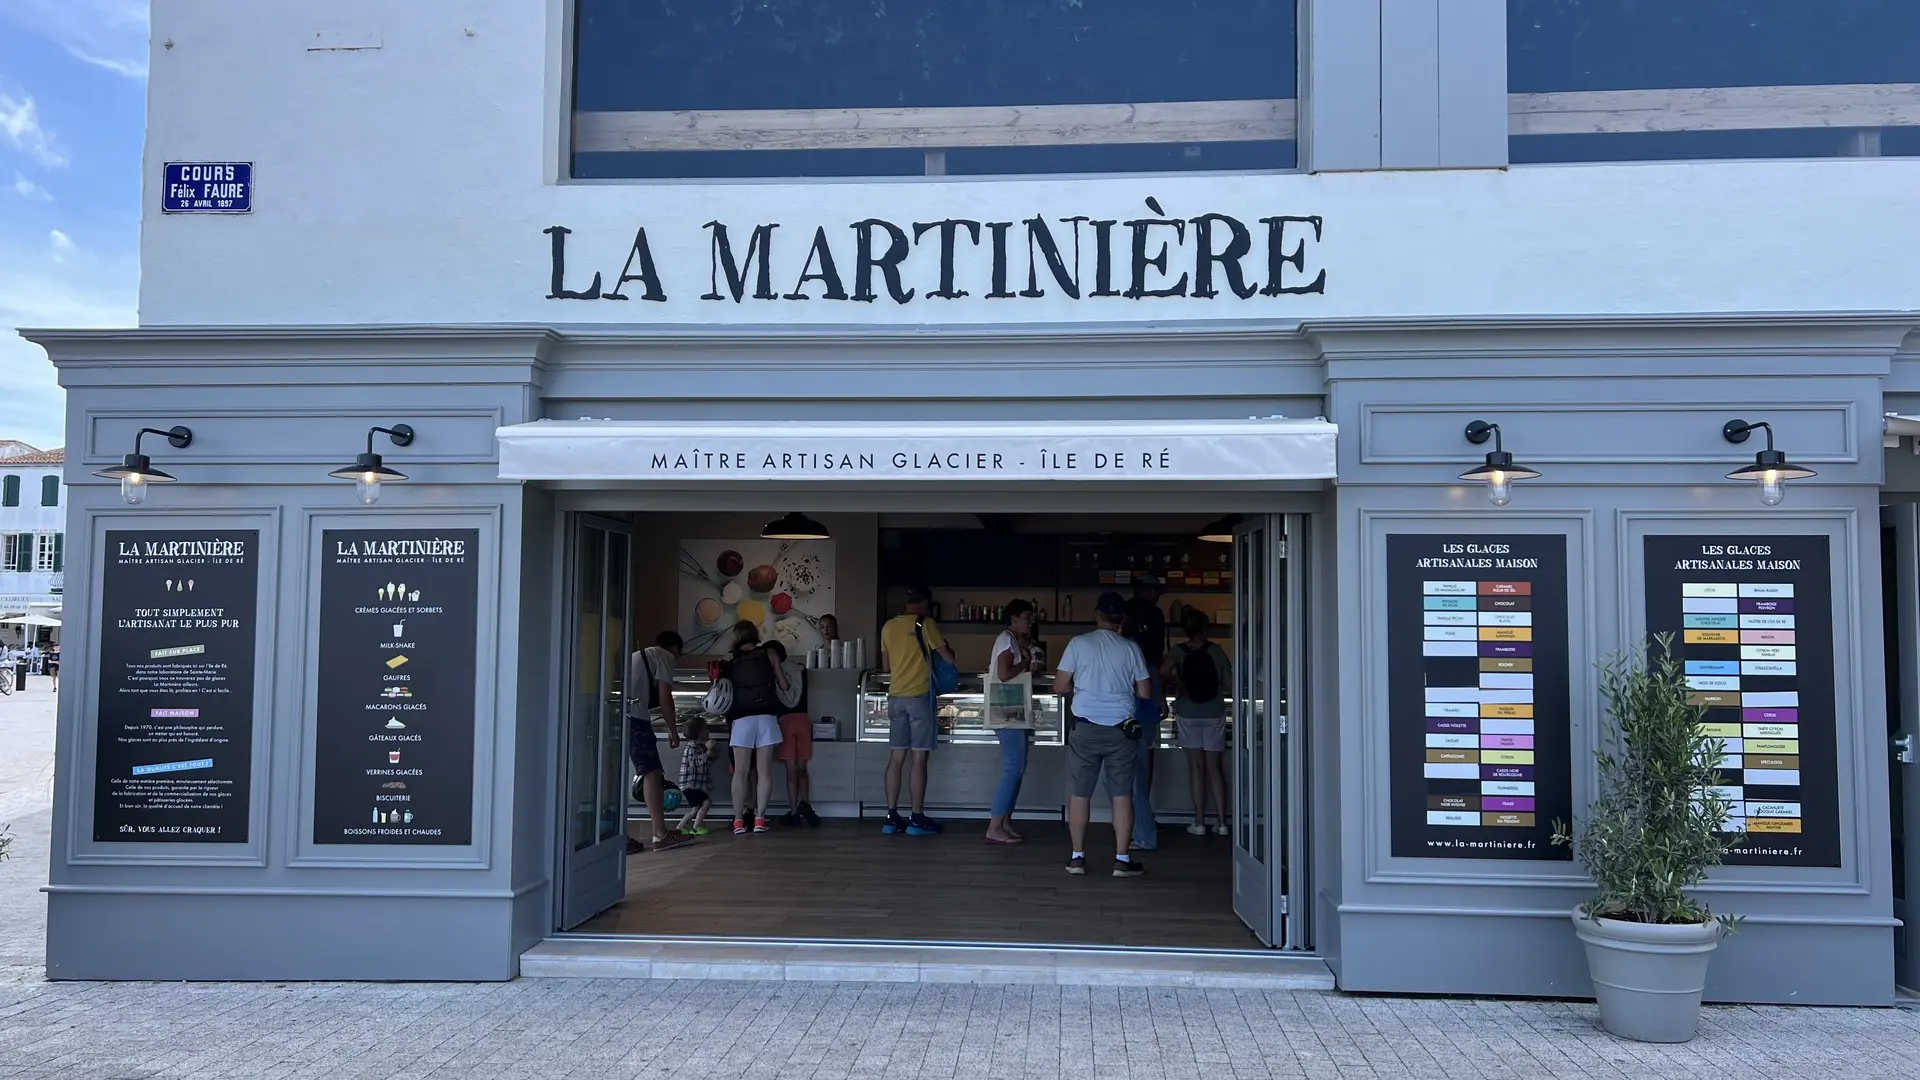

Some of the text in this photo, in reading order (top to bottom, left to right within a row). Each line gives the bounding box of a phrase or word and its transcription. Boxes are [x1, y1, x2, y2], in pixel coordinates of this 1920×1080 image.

[182, 166, 234, 181] COURS
[171, 184, 243, 198] Félix FAURE
[543, 196, 1327, 304] LA MARTINIÈRE
[651, 449, 746, 469] MAÎTRE
[762, 453, 874, 469] ARTISAN
[892, 453, 1003, 469] GLACIER
[1041, 448, 1076, 469] ÎLE
[1095, 453, 1124, 469] DE
[1142, 448, 1170, 469] RÉ
[119, 538, 244, 556] LA MARTINIÈRE
[337, 537, 464, 556] LA MARTINIÈRE
[1443, 544, 1509, 553] LES GLACES
[1702, 546, 1771, 555] LES GLACES
[1416, 558, 1538, 568] ARTISANALES MAISON
[1674, 560, 1800, 570] ARTISANALES MAISON
[135, 608, 224, 617] TOUT SIMPLEMENT
[119, 620, 177, 628] L'ARTISANAT
[1427, 839, 1536, 849] www.la-martiniere.fr
